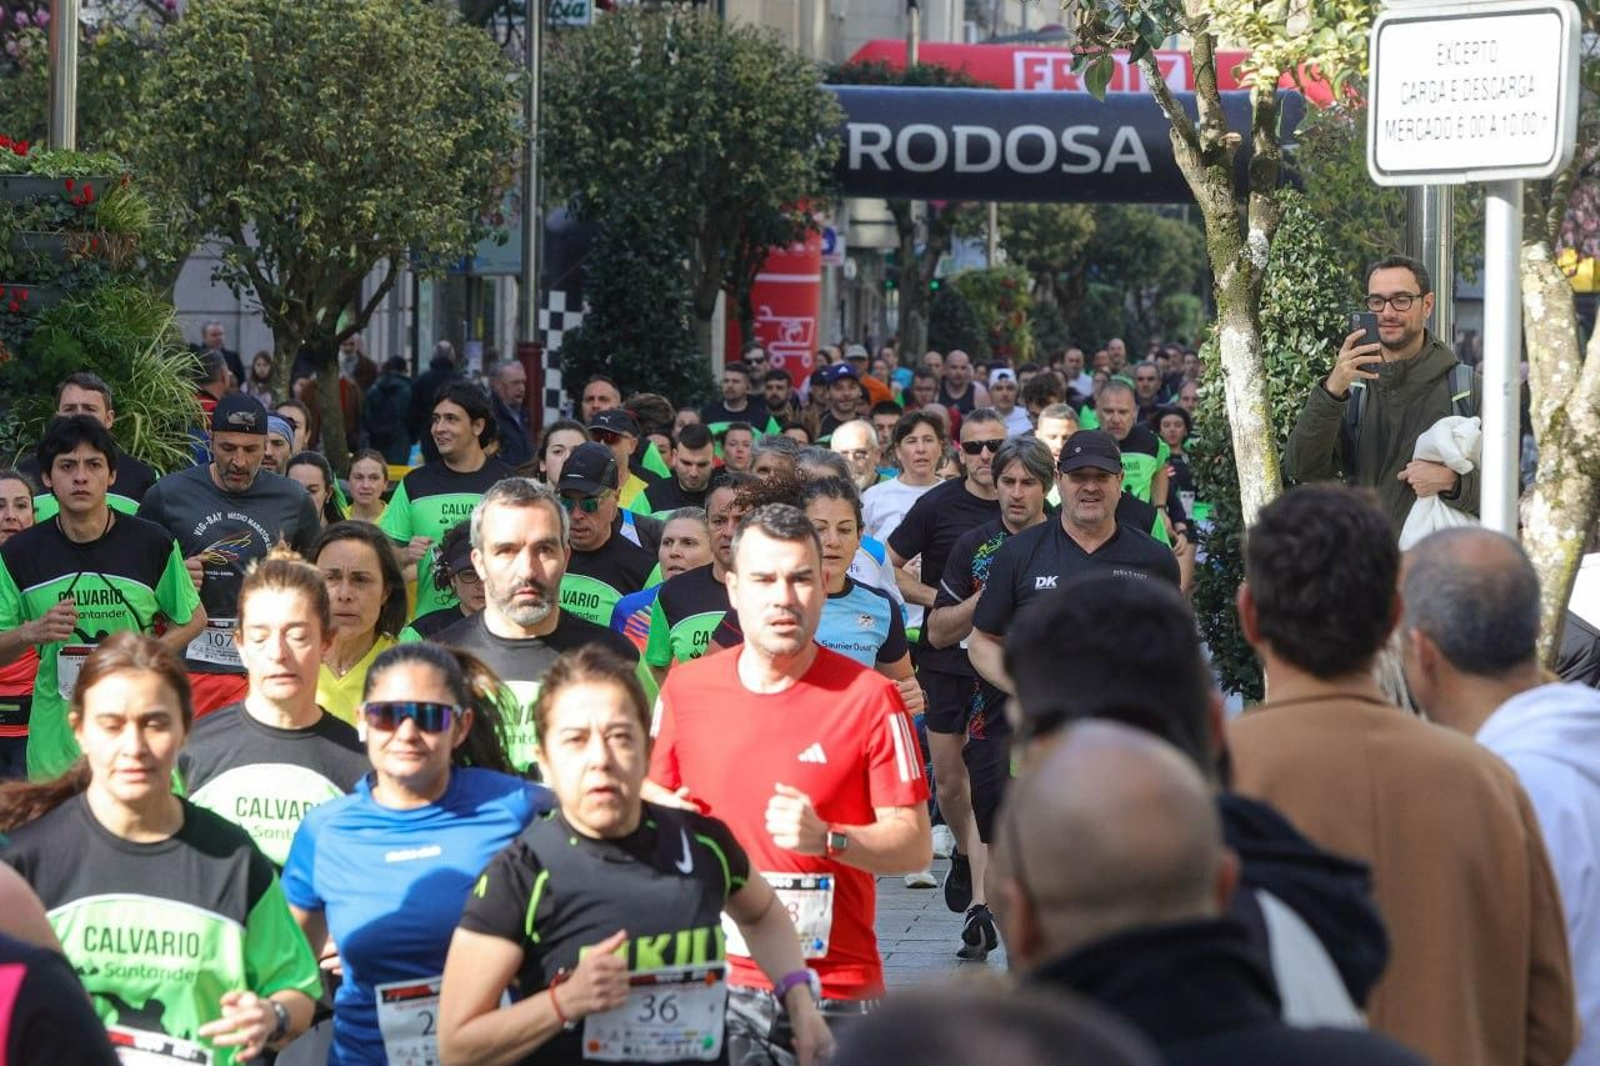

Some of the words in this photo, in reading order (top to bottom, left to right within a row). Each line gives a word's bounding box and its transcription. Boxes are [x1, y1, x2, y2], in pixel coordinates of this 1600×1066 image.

[1436, 39, 1498, 66] EXCEPTO
[1400, 80, 1447, 105] CARGA
[1450, 78, 1458, 102] E
[1462, 75, 1536, 102] DESCARGA
[1384, 117, 1452, 142] MERCADO
[847, 122, 1152, 173] RODOSA
[1035, 576, 1059, 588] DK
[78, 609, 127, 620] antander
[83, 925, 200, 958] CALVARIO
[639, 994, 679, 1024] 36
